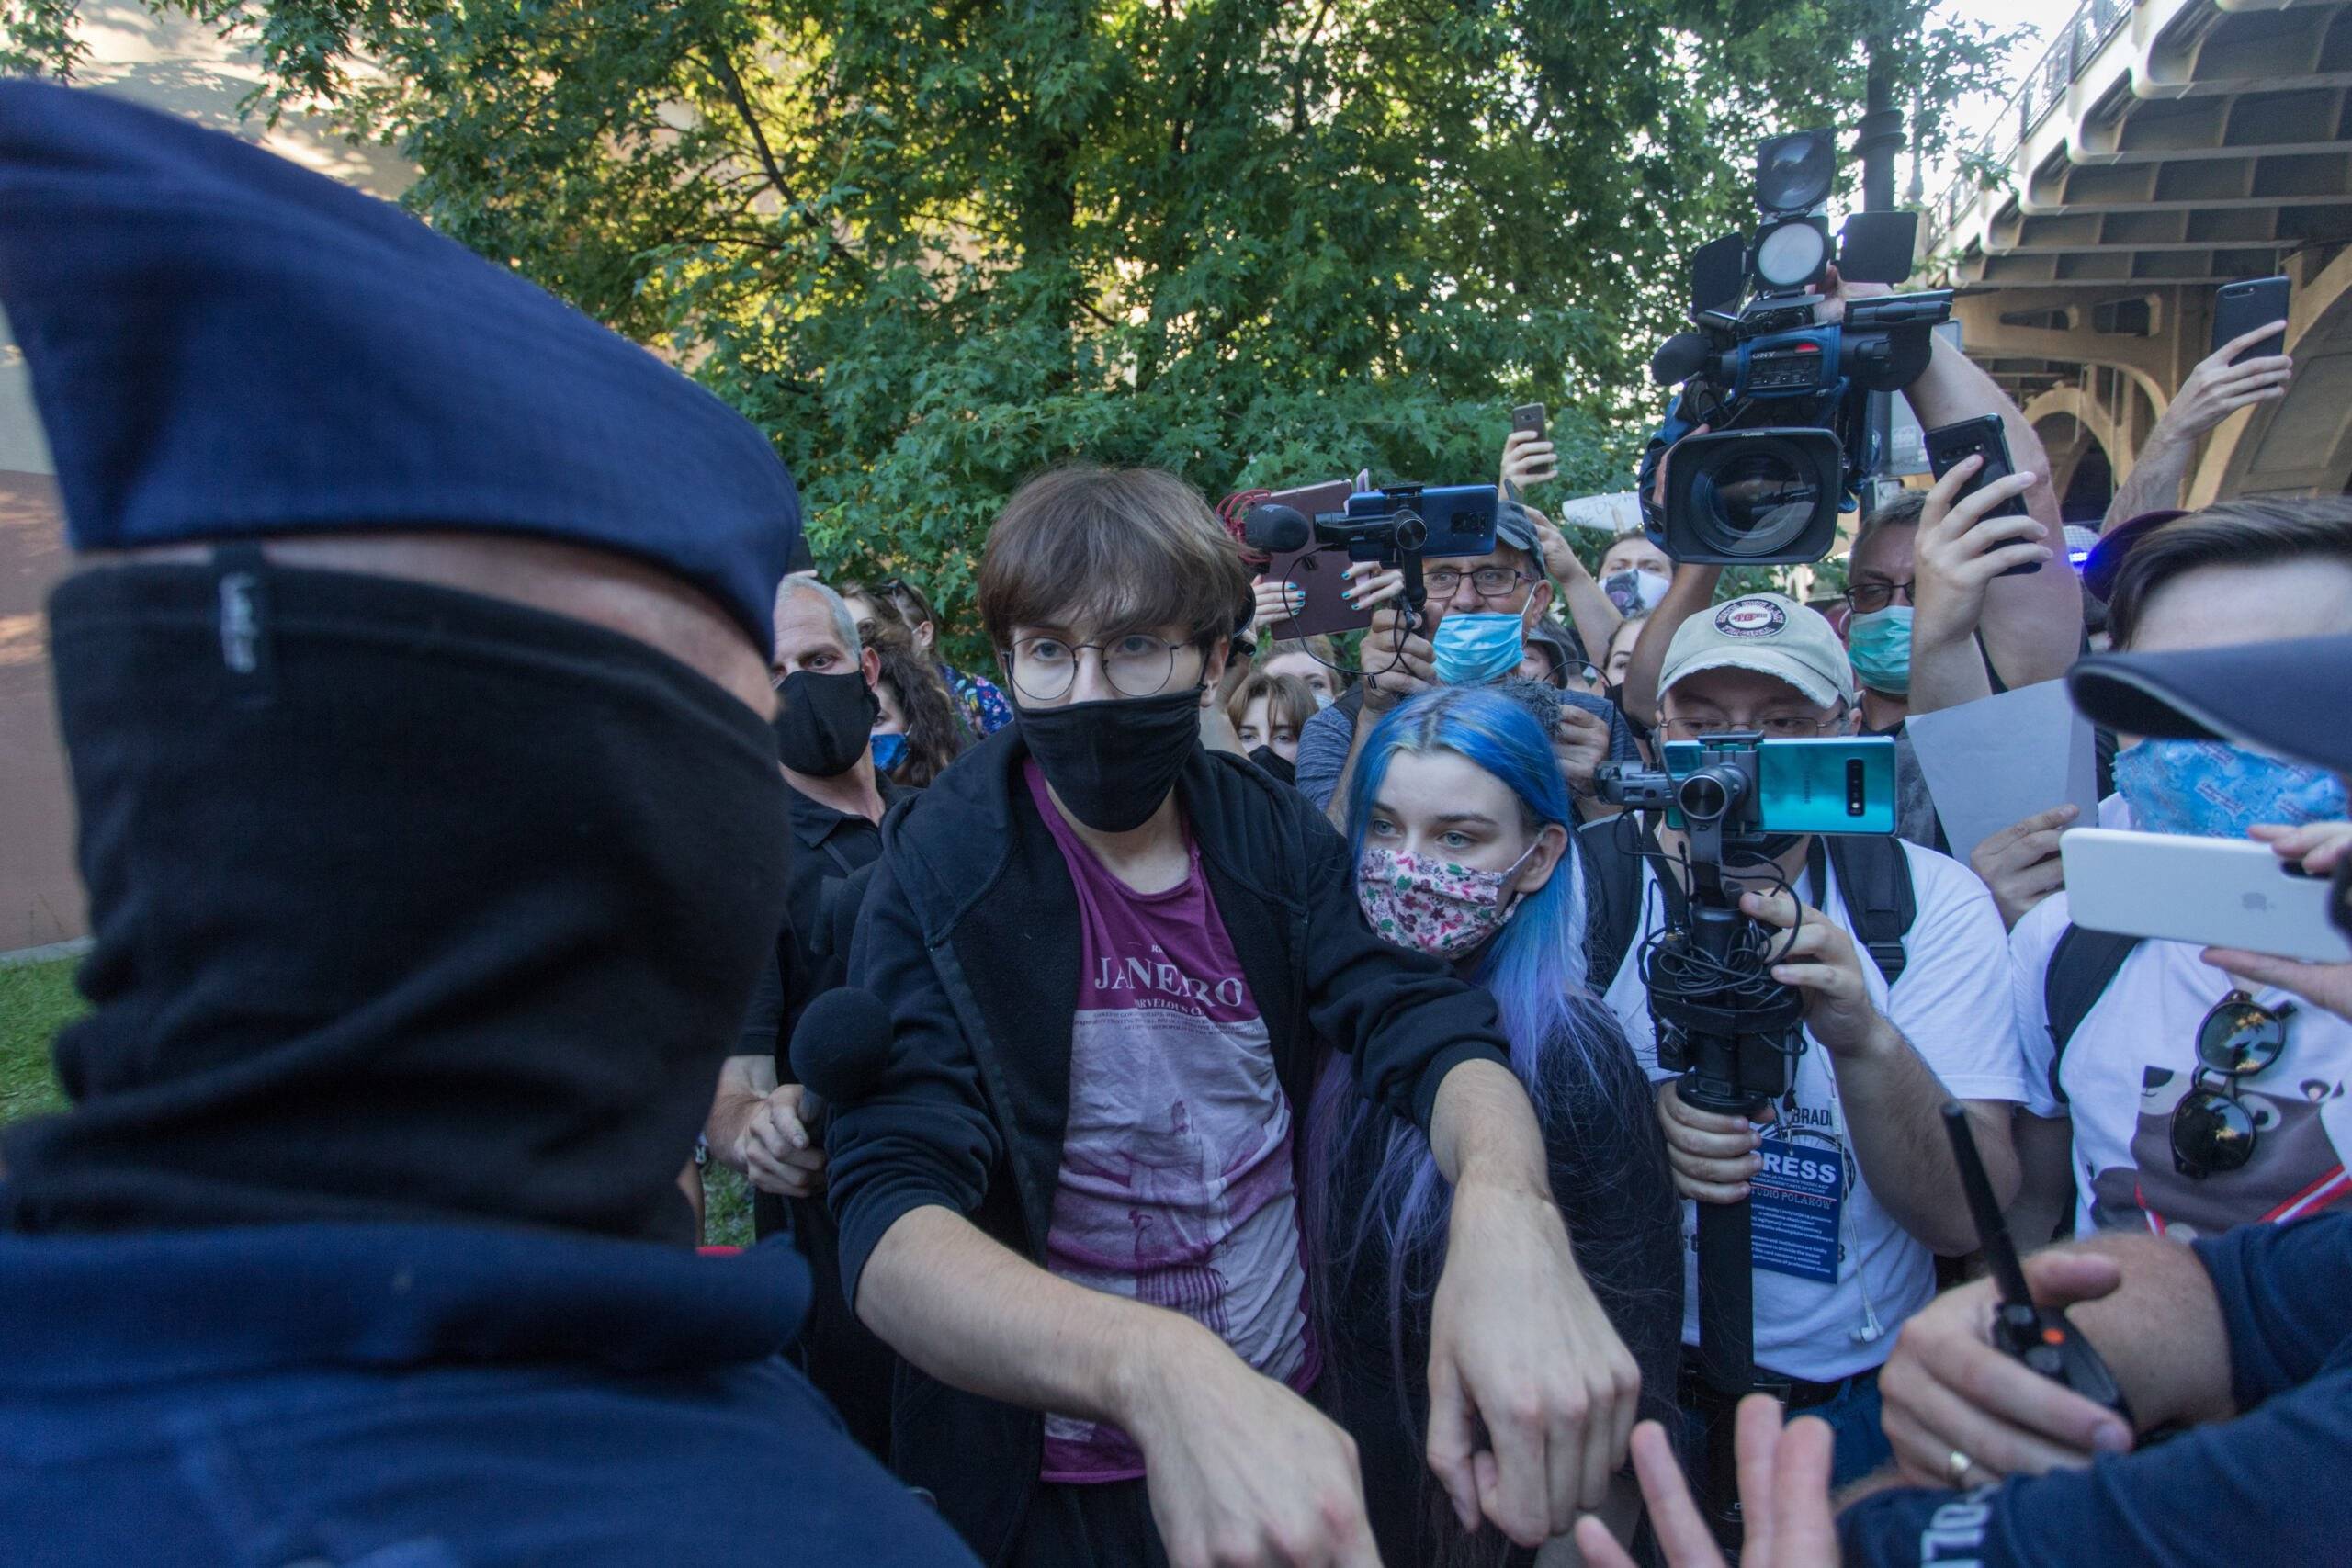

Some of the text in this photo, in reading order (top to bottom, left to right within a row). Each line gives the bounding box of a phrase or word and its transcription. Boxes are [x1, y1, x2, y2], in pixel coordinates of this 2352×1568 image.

[1751, 351, 1776, 359] ONY
[1793, 1108, 1833, 1126] BRAD
[1749, 1186, 1780, 1199] TUDIO
